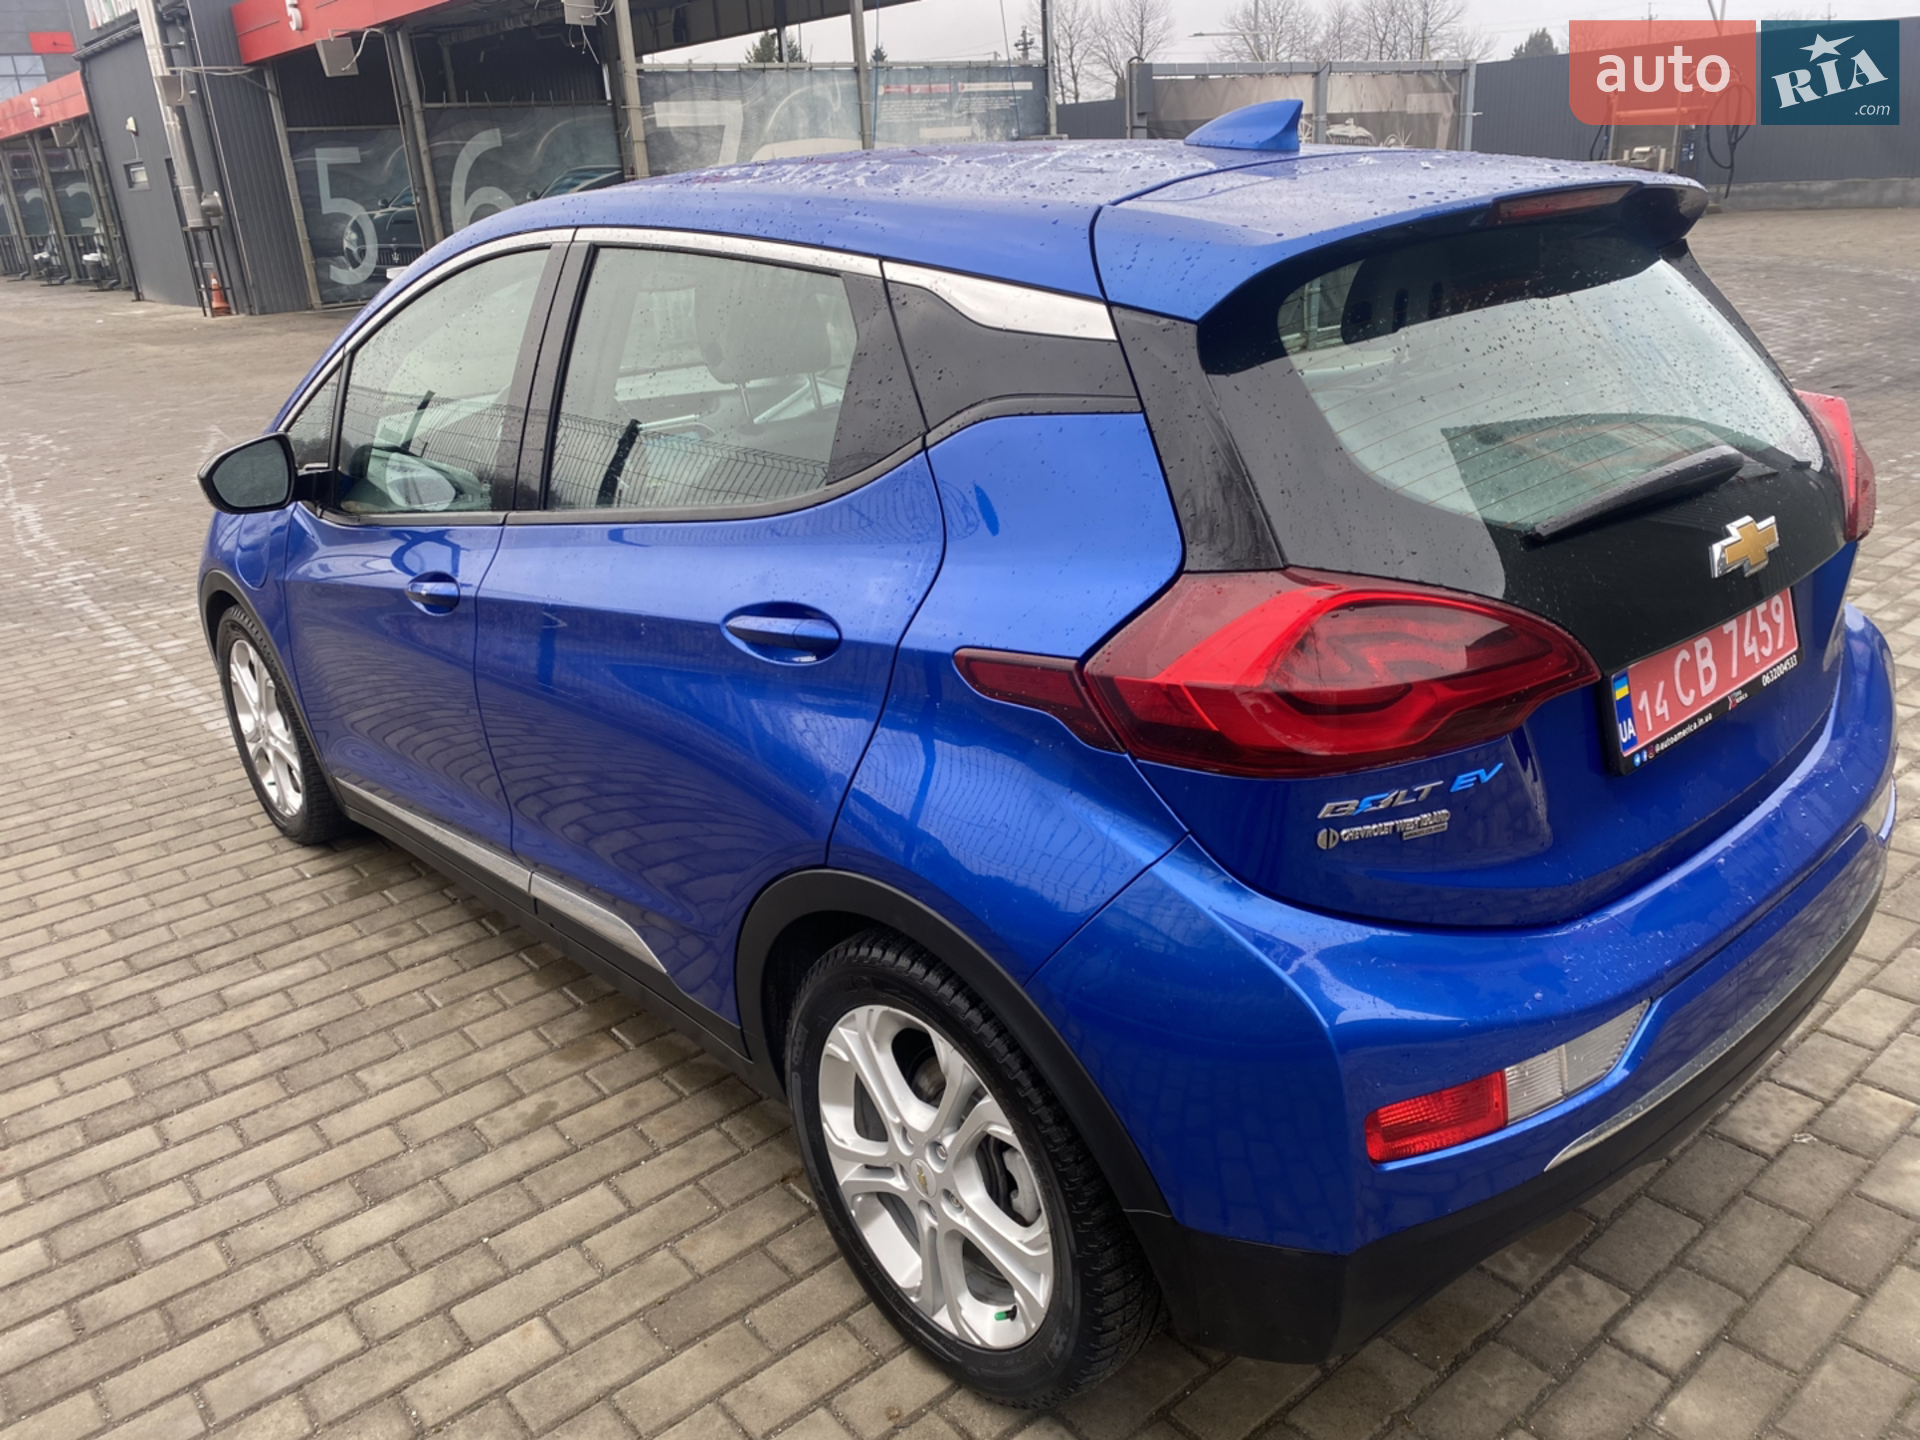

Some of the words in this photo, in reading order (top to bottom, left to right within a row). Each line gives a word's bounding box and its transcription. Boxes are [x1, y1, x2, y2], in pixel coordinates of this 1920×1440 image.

[315, 147, 378, 286] 5
[1637, 679, 1670, 733] 14
[1674, 636, 1717, 707] CB
[1722, 594, 1785, 680] 7459
[1618, 718, 1637, 744] UA
[1317, 780, 1445, 819] BOLT
[1450, 762, 1504, 793] EV
[1340, 821, 1395, 842] CHEVROLET
